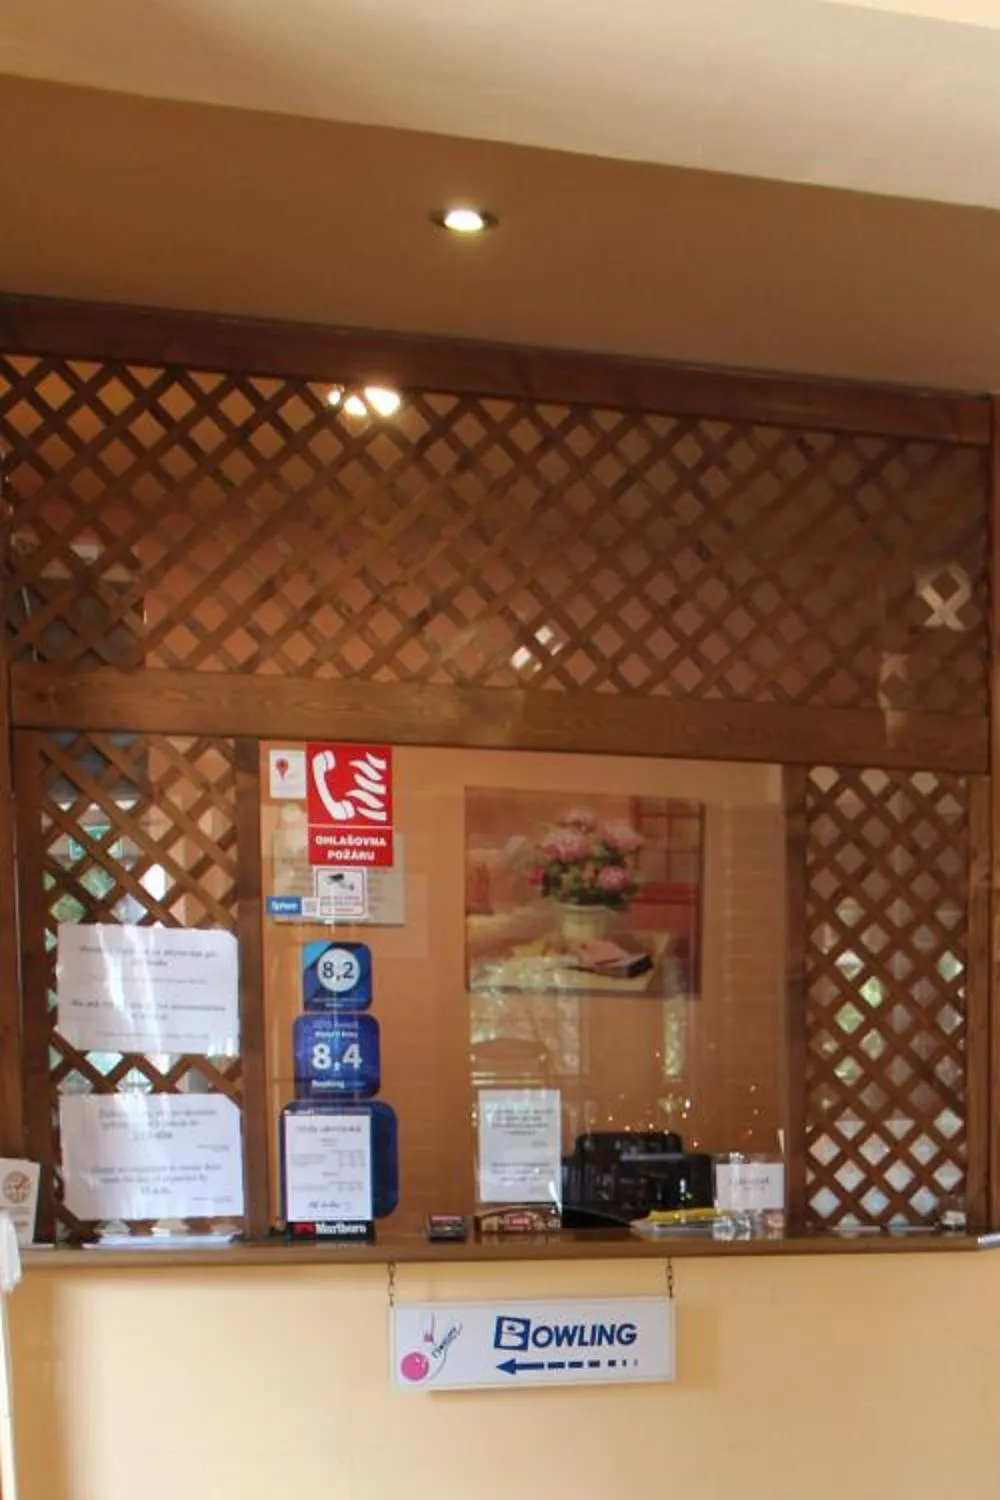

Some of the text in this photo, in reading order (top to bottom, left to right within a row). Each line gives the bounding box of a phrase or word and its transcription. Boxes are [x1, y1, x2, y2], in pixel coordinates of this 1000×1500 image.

[315, 834, 387, 847] OHLAŠOVNA
[327, 849, 376, 861] POŽÁRU
[322, 961, 355, 981] 8,2
[493, 1315, 638, 1352] BOWLING
